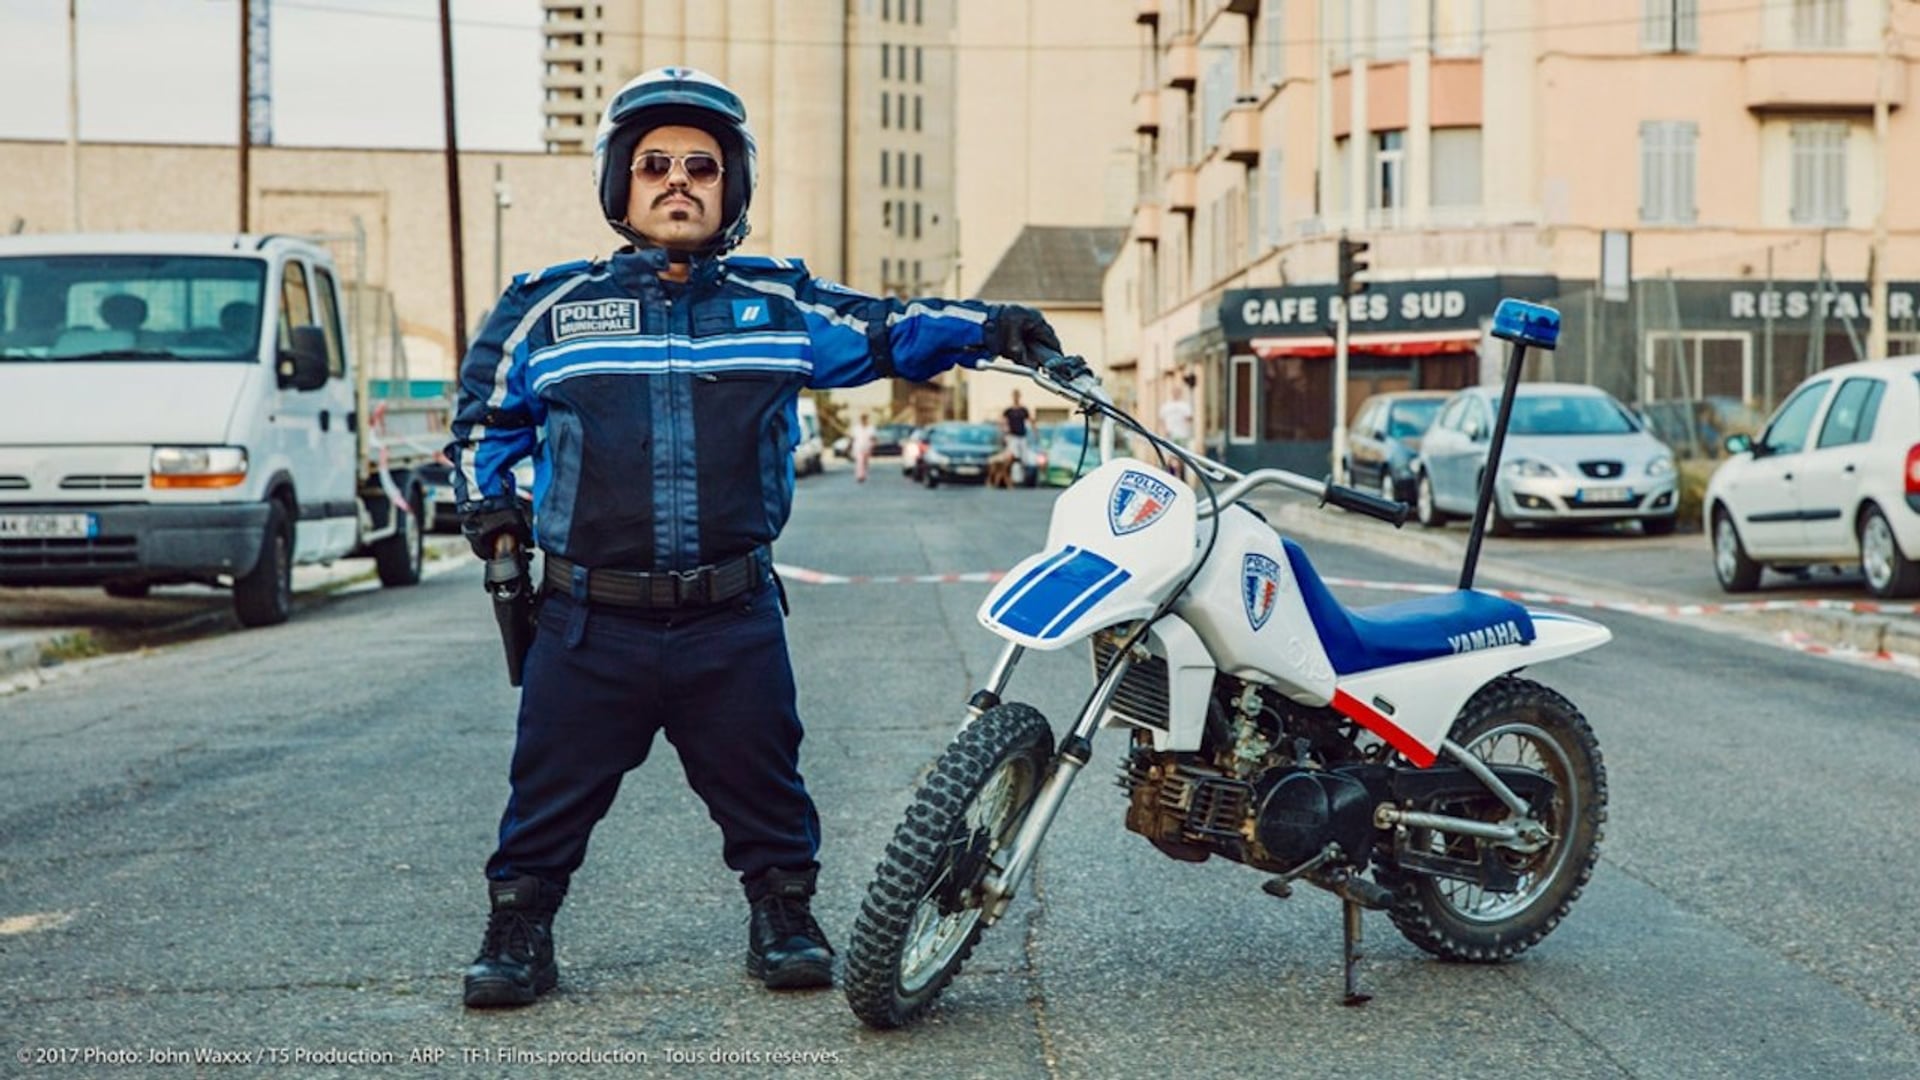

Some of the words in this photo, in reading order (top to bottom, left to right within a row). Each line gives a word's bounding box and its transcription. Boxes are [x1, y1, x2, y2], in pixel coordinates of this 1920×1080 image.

[560, 302, 632, 323] POLICE
[1242, 297, 1318, 326] CAFE
[1400, 290, 1466, 320] SUD
[1730, 291, 1920, 319] RESTAUR
[560, 317, 632, 336] MUNICIPALE
[1123, 473, 1173, 500] POLICE
[1447, 620, 1522, 654] YAMAHA
